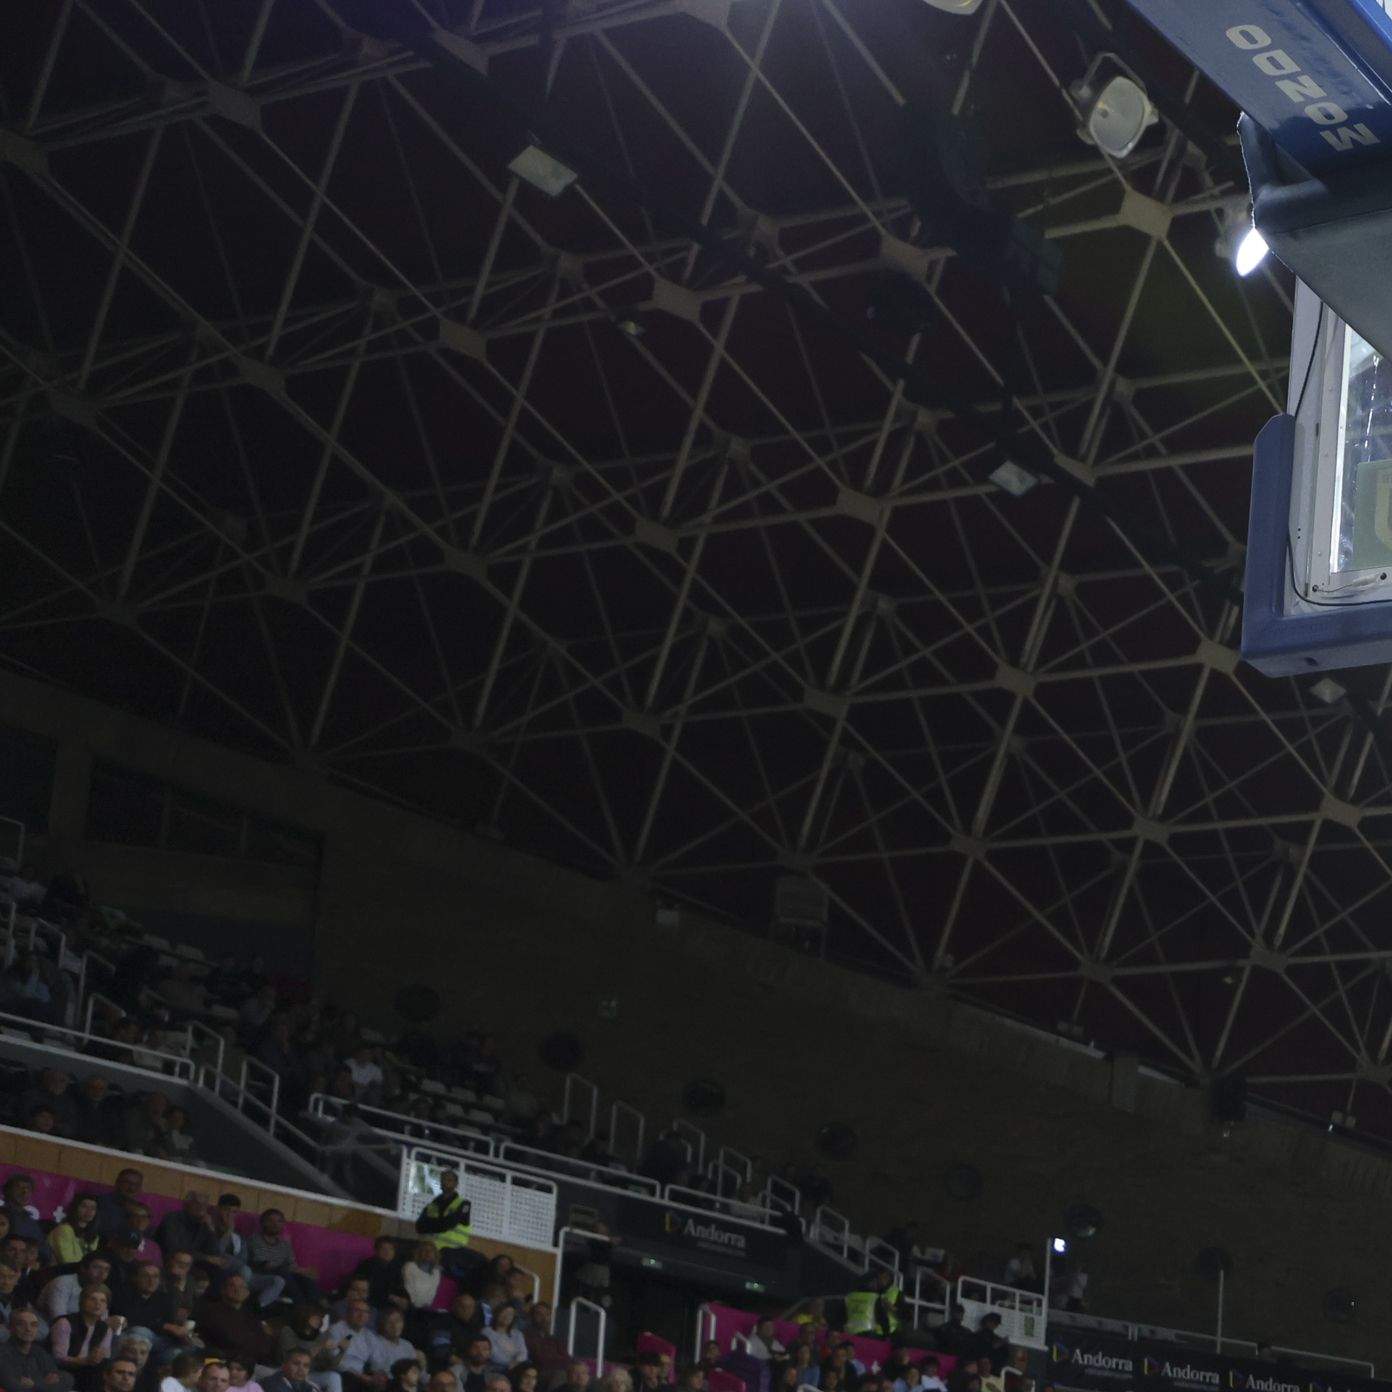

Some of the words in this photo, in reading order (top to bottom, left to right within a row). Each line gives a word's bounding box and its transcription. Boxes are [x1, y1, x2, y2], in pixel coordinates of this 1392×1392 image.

[1225, 24, 1381, 151] MONDO
[1071, 1349, 1133, 1371] Andorra
[1160, 1362, 1220, 1384] Andorra
